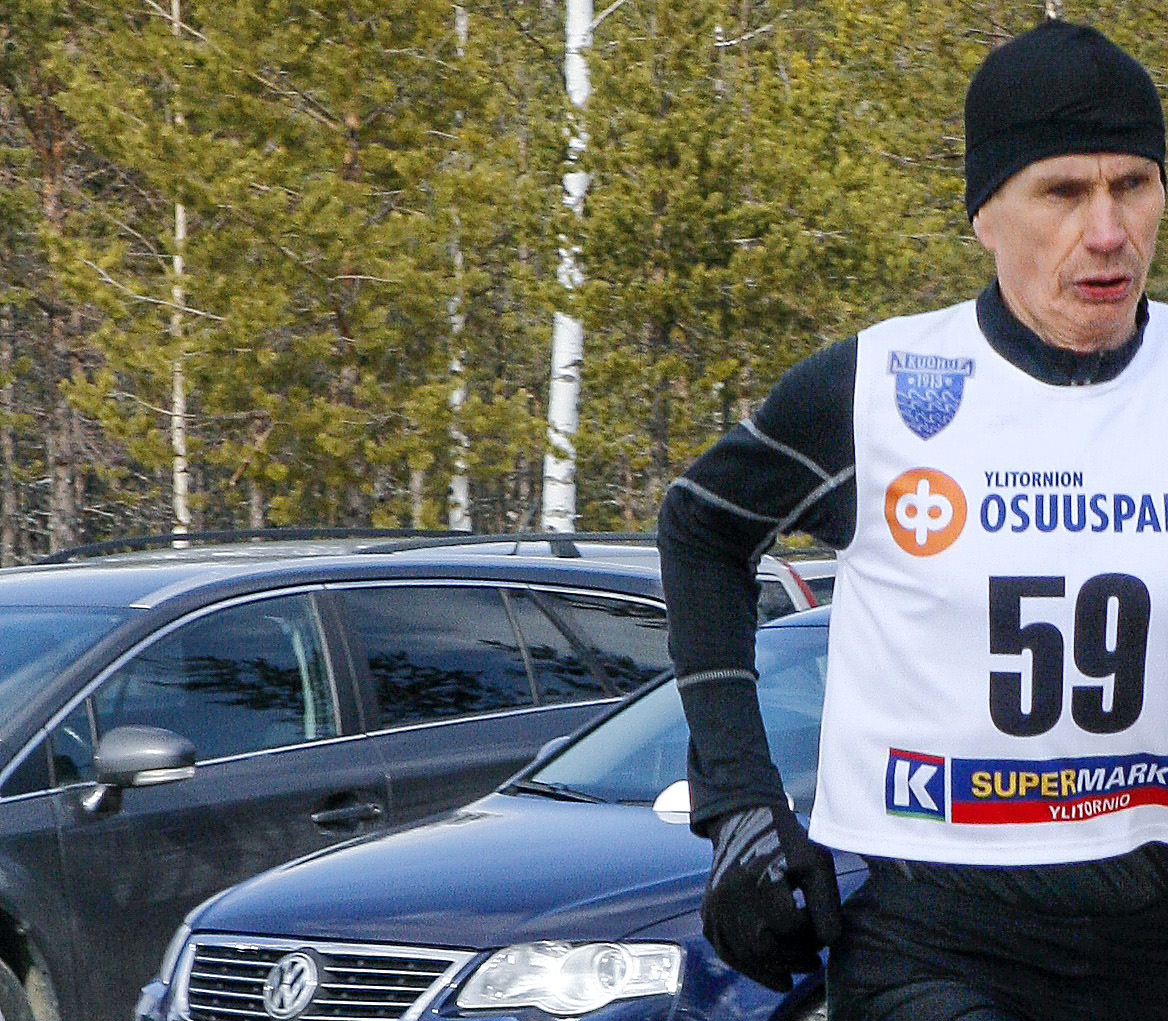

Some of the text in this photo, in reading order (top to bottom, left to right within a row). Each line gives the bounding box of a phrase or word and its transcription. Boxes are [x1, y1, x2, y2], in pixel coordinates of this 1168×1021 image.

[984, 471, 1084, 488] YLITORNION
[989, 573, 1151, 738] 59
[893, 759, 939, 812] K
[1048, 793, 1131, 820] YLITORNIO
